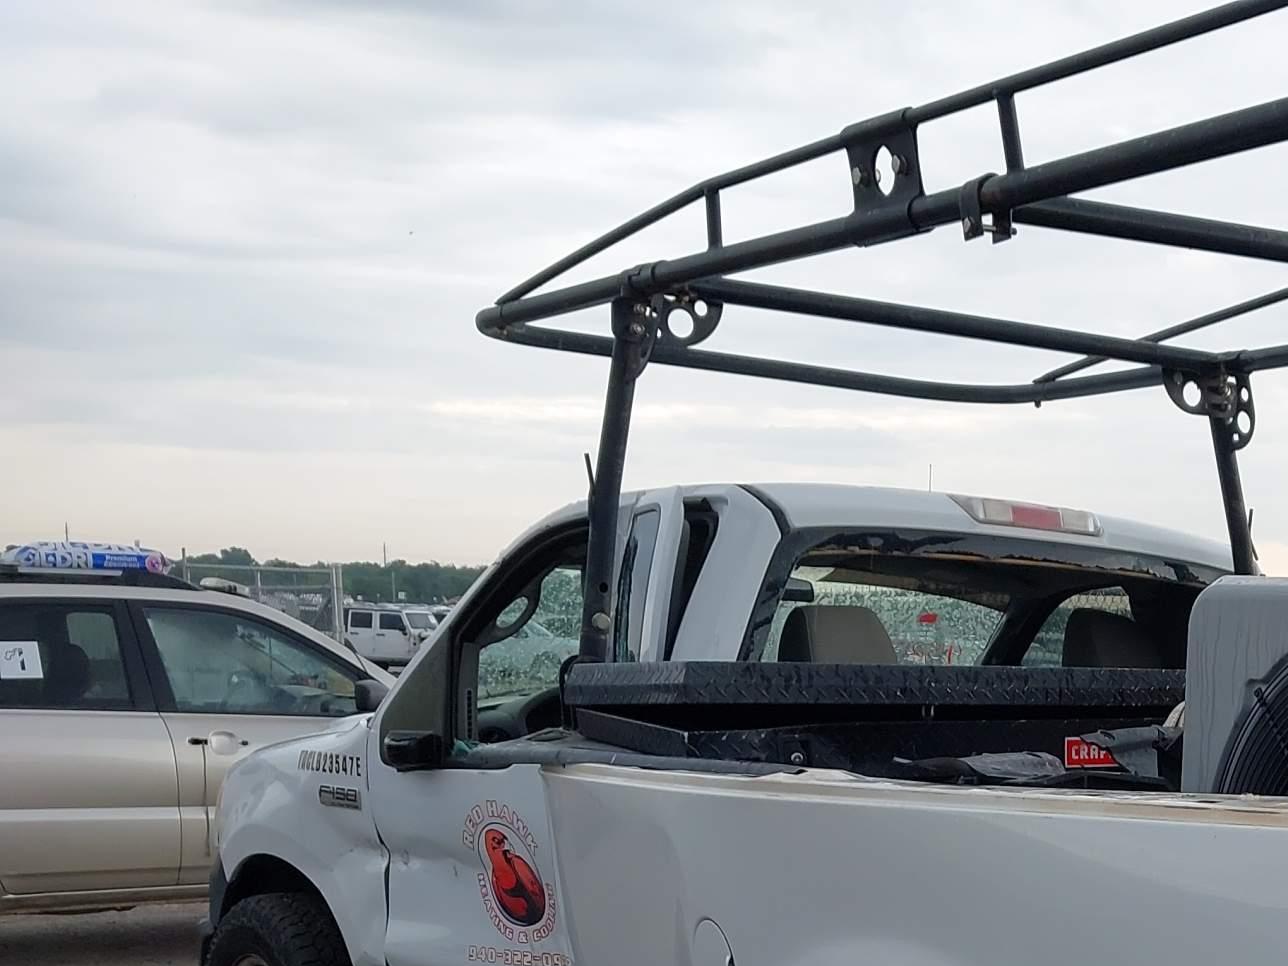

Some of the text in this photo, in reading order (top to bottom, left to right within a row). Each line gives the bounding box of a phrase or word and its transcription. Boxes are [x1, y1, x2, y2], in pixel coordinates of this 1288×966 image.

[462, 800, 538, 855] RED HAWK
[477, 872, 515, 941] HEATING
[517, 931, 529, 944] &
